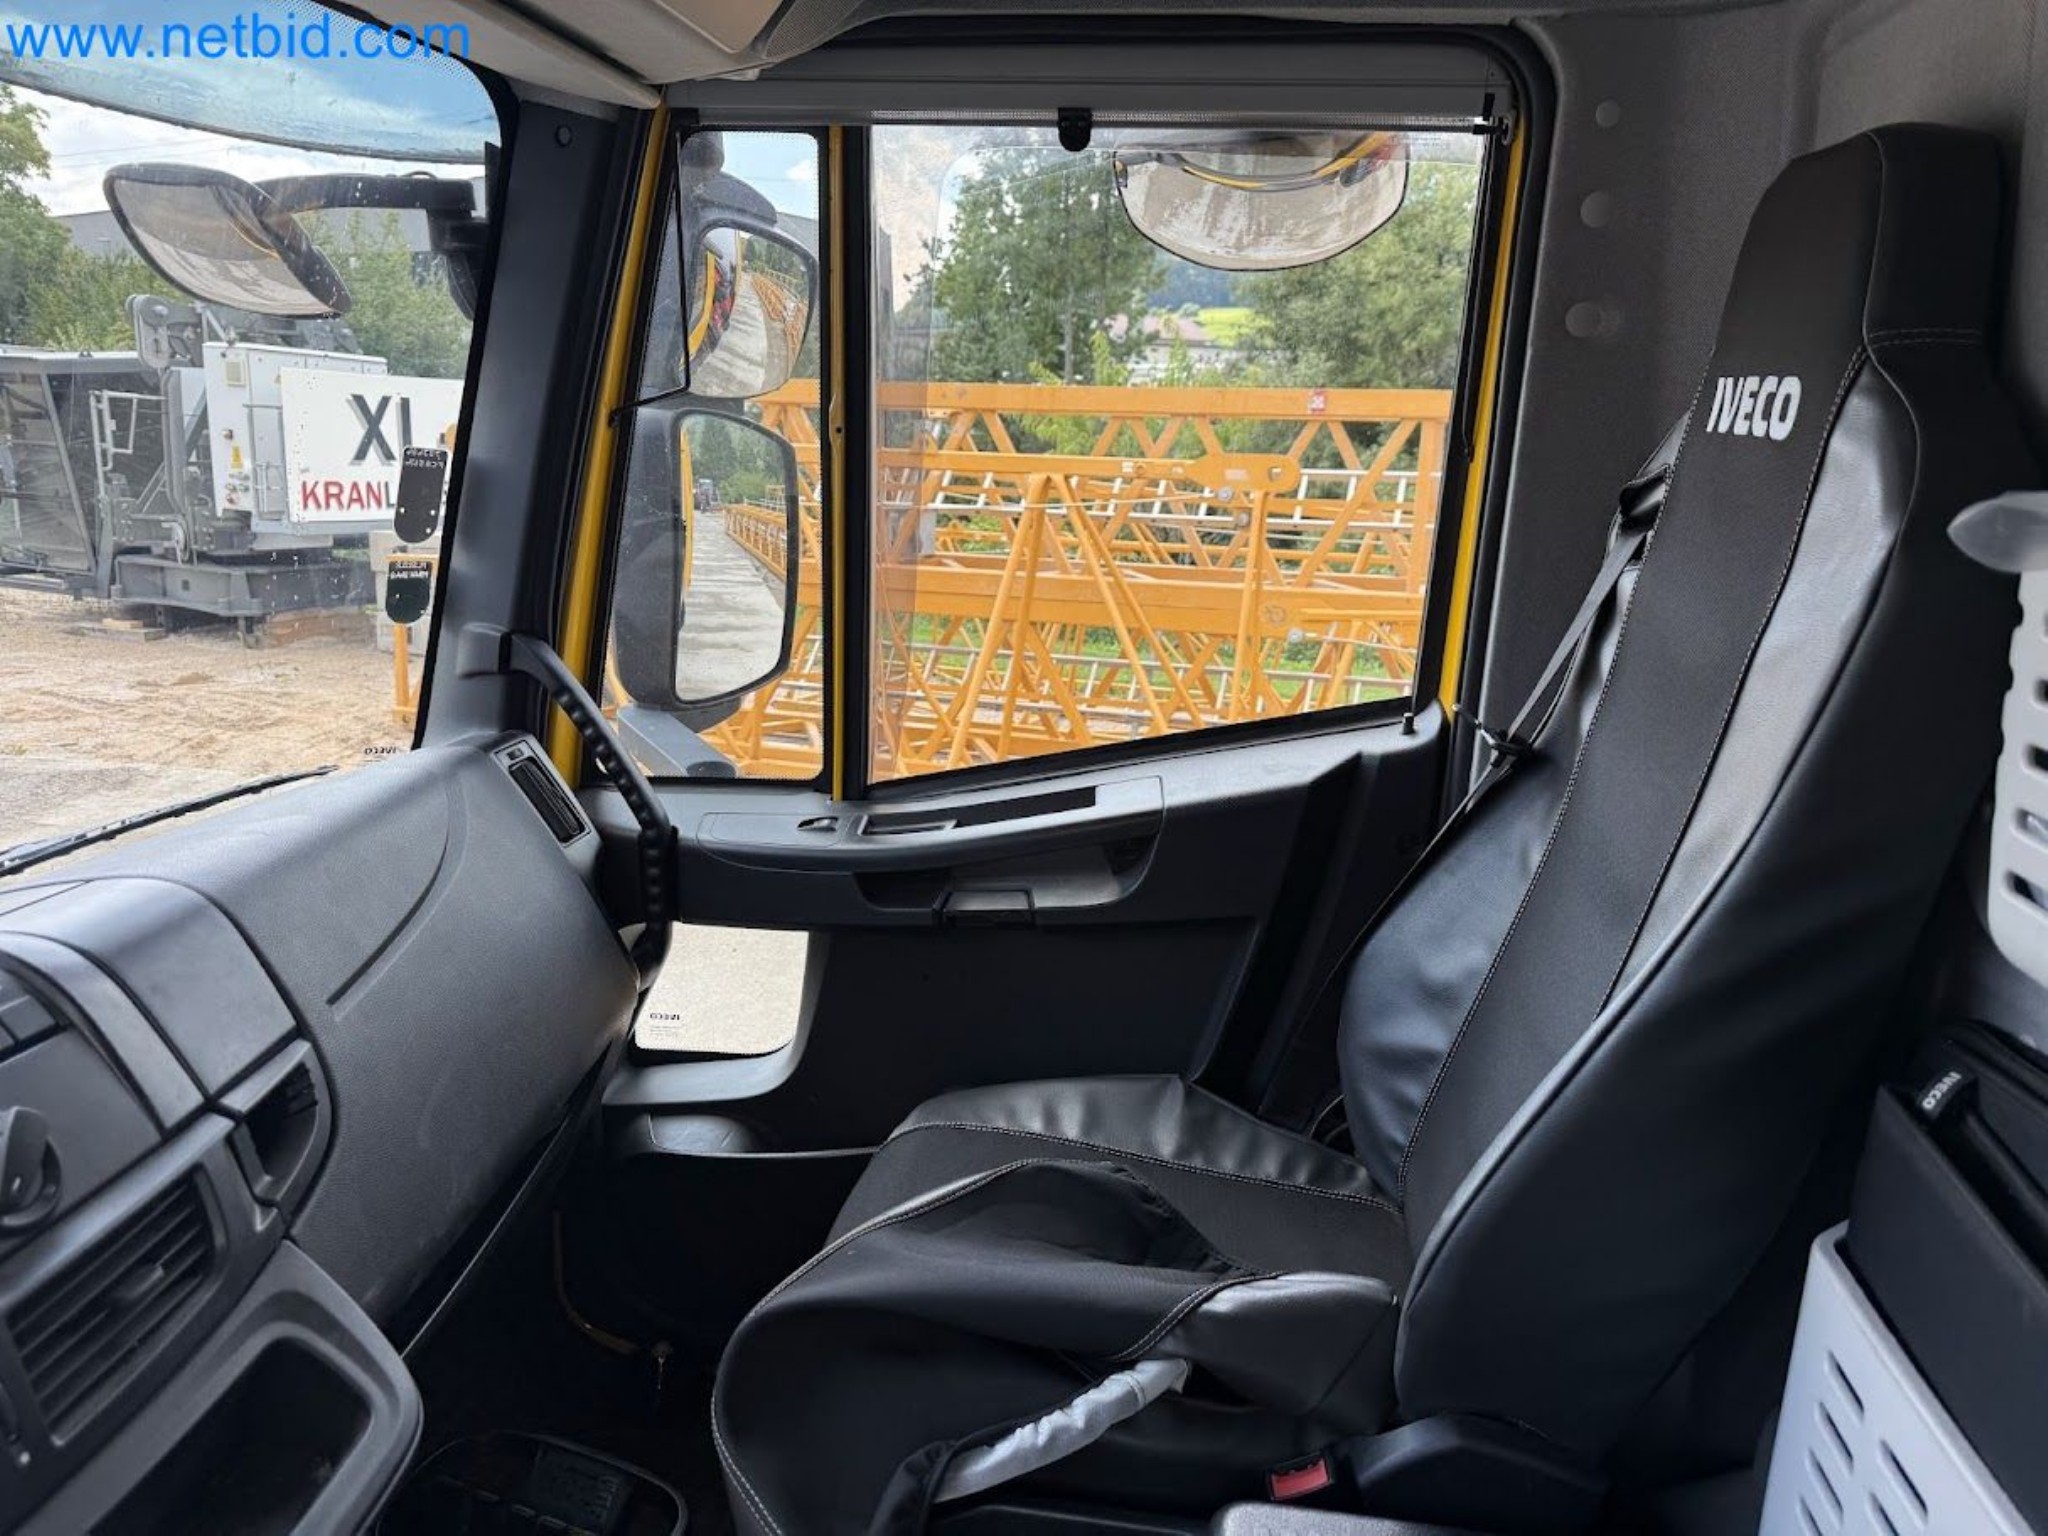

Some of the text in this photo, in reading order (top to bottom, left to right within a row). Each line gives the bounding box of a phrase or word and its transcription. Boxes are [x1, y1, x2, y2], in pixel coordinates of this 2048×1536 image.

[1705, 375, 1802, 441] IVECO
[302, 480, 397, 512] KRANL
[1922, 1071, 1962, 1110] IVECO
